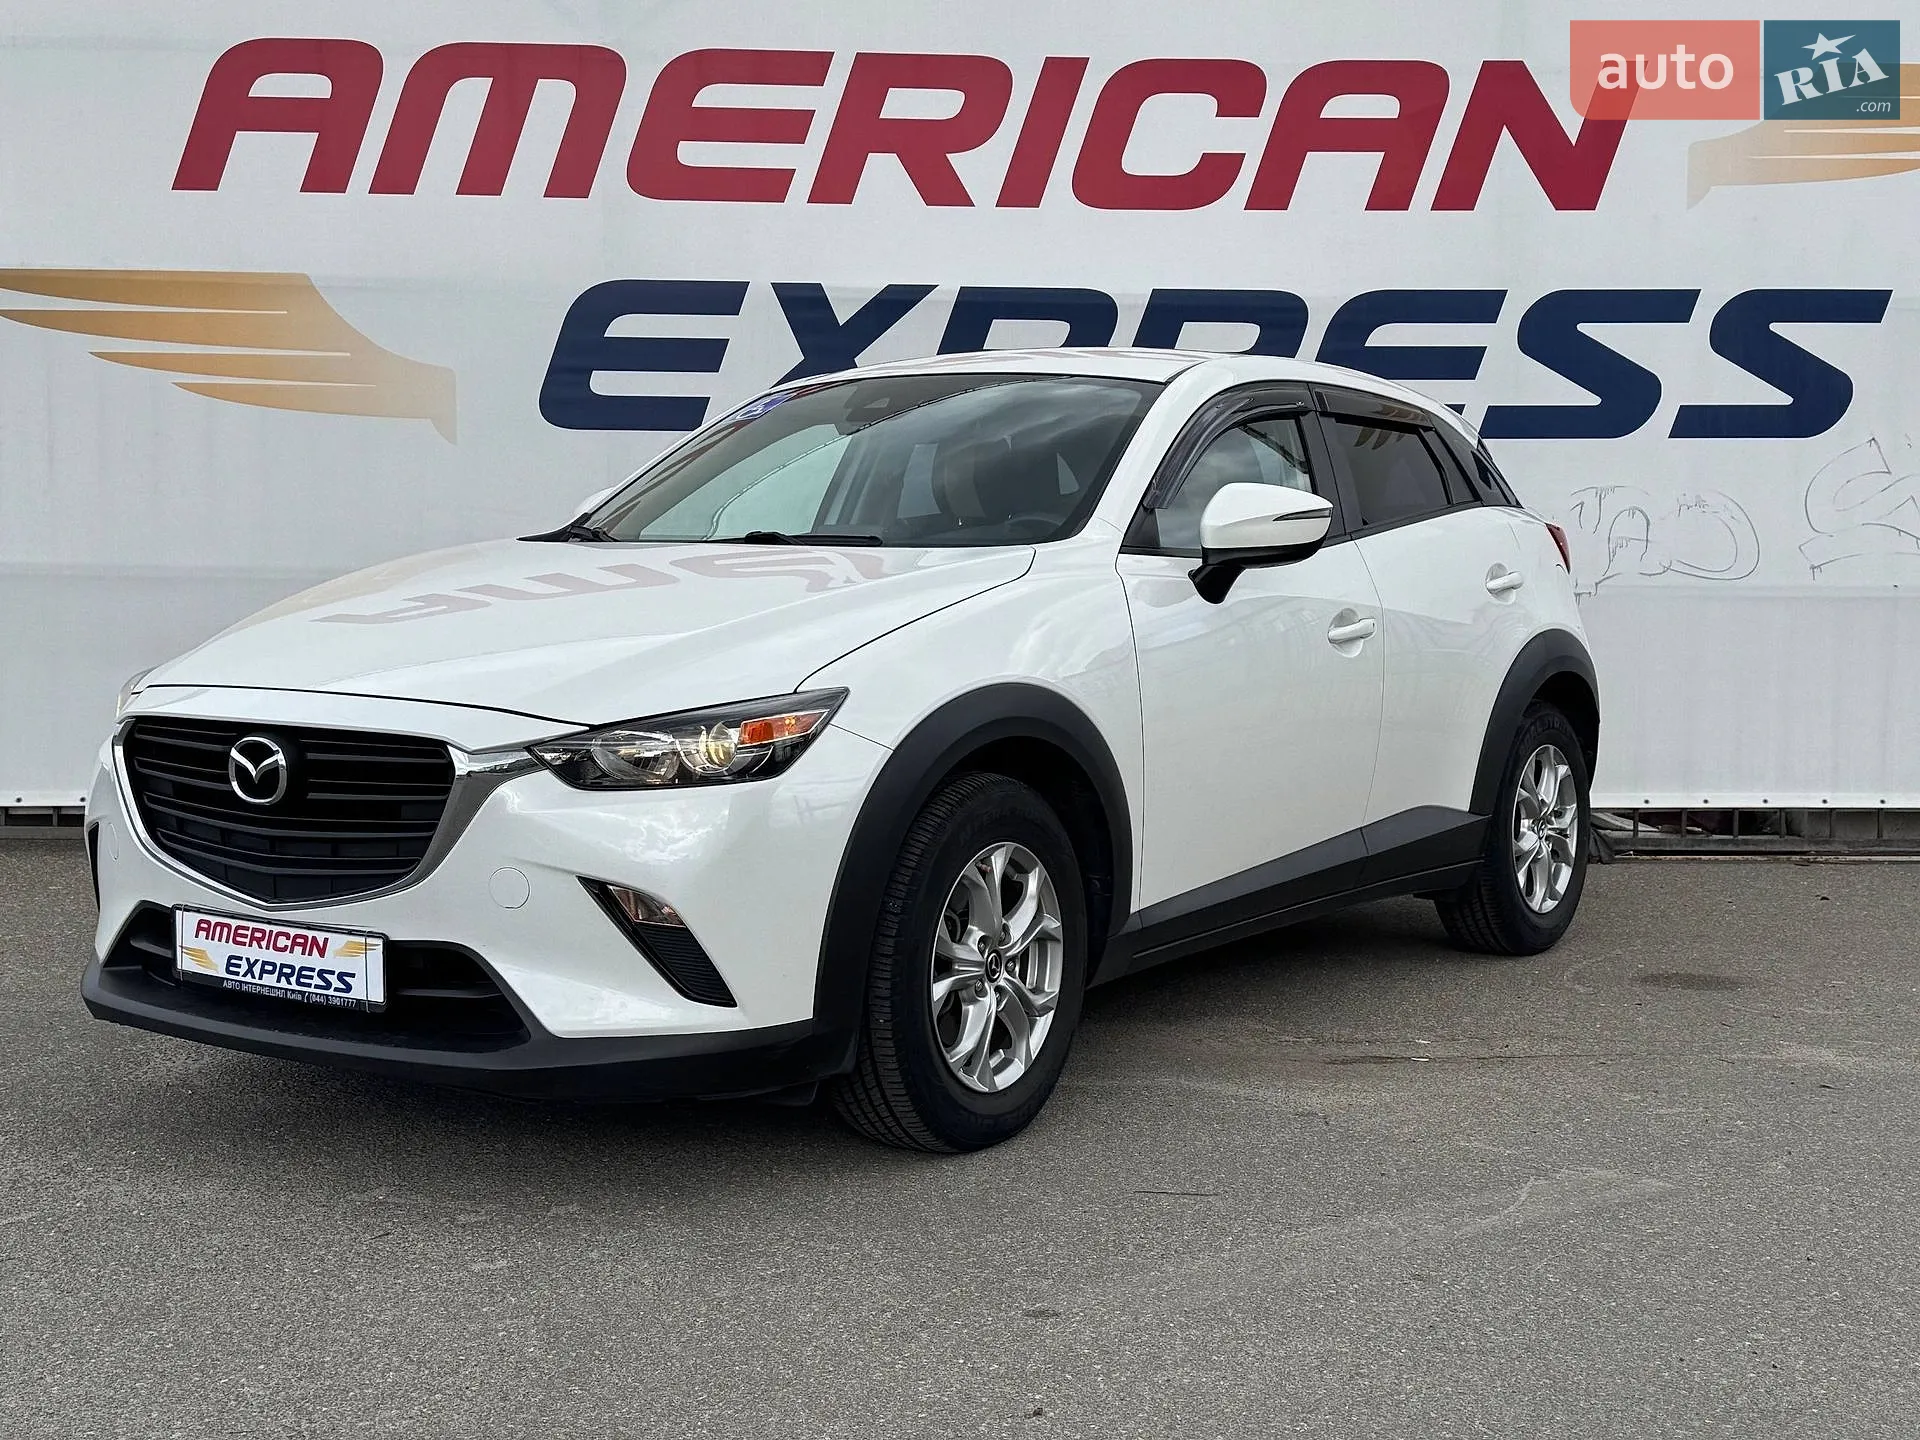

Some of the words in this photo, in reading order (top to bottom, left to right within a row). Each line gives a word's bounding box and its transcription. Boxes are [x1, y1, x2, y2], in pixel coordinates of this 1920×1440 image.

[172, 37, 1648, 211] AMERICAN
[194, 918, 329, 958] AMERICAN
[222, 979, 241, 991] АВТО
[225, 954, 356, 994] EXPRESS
